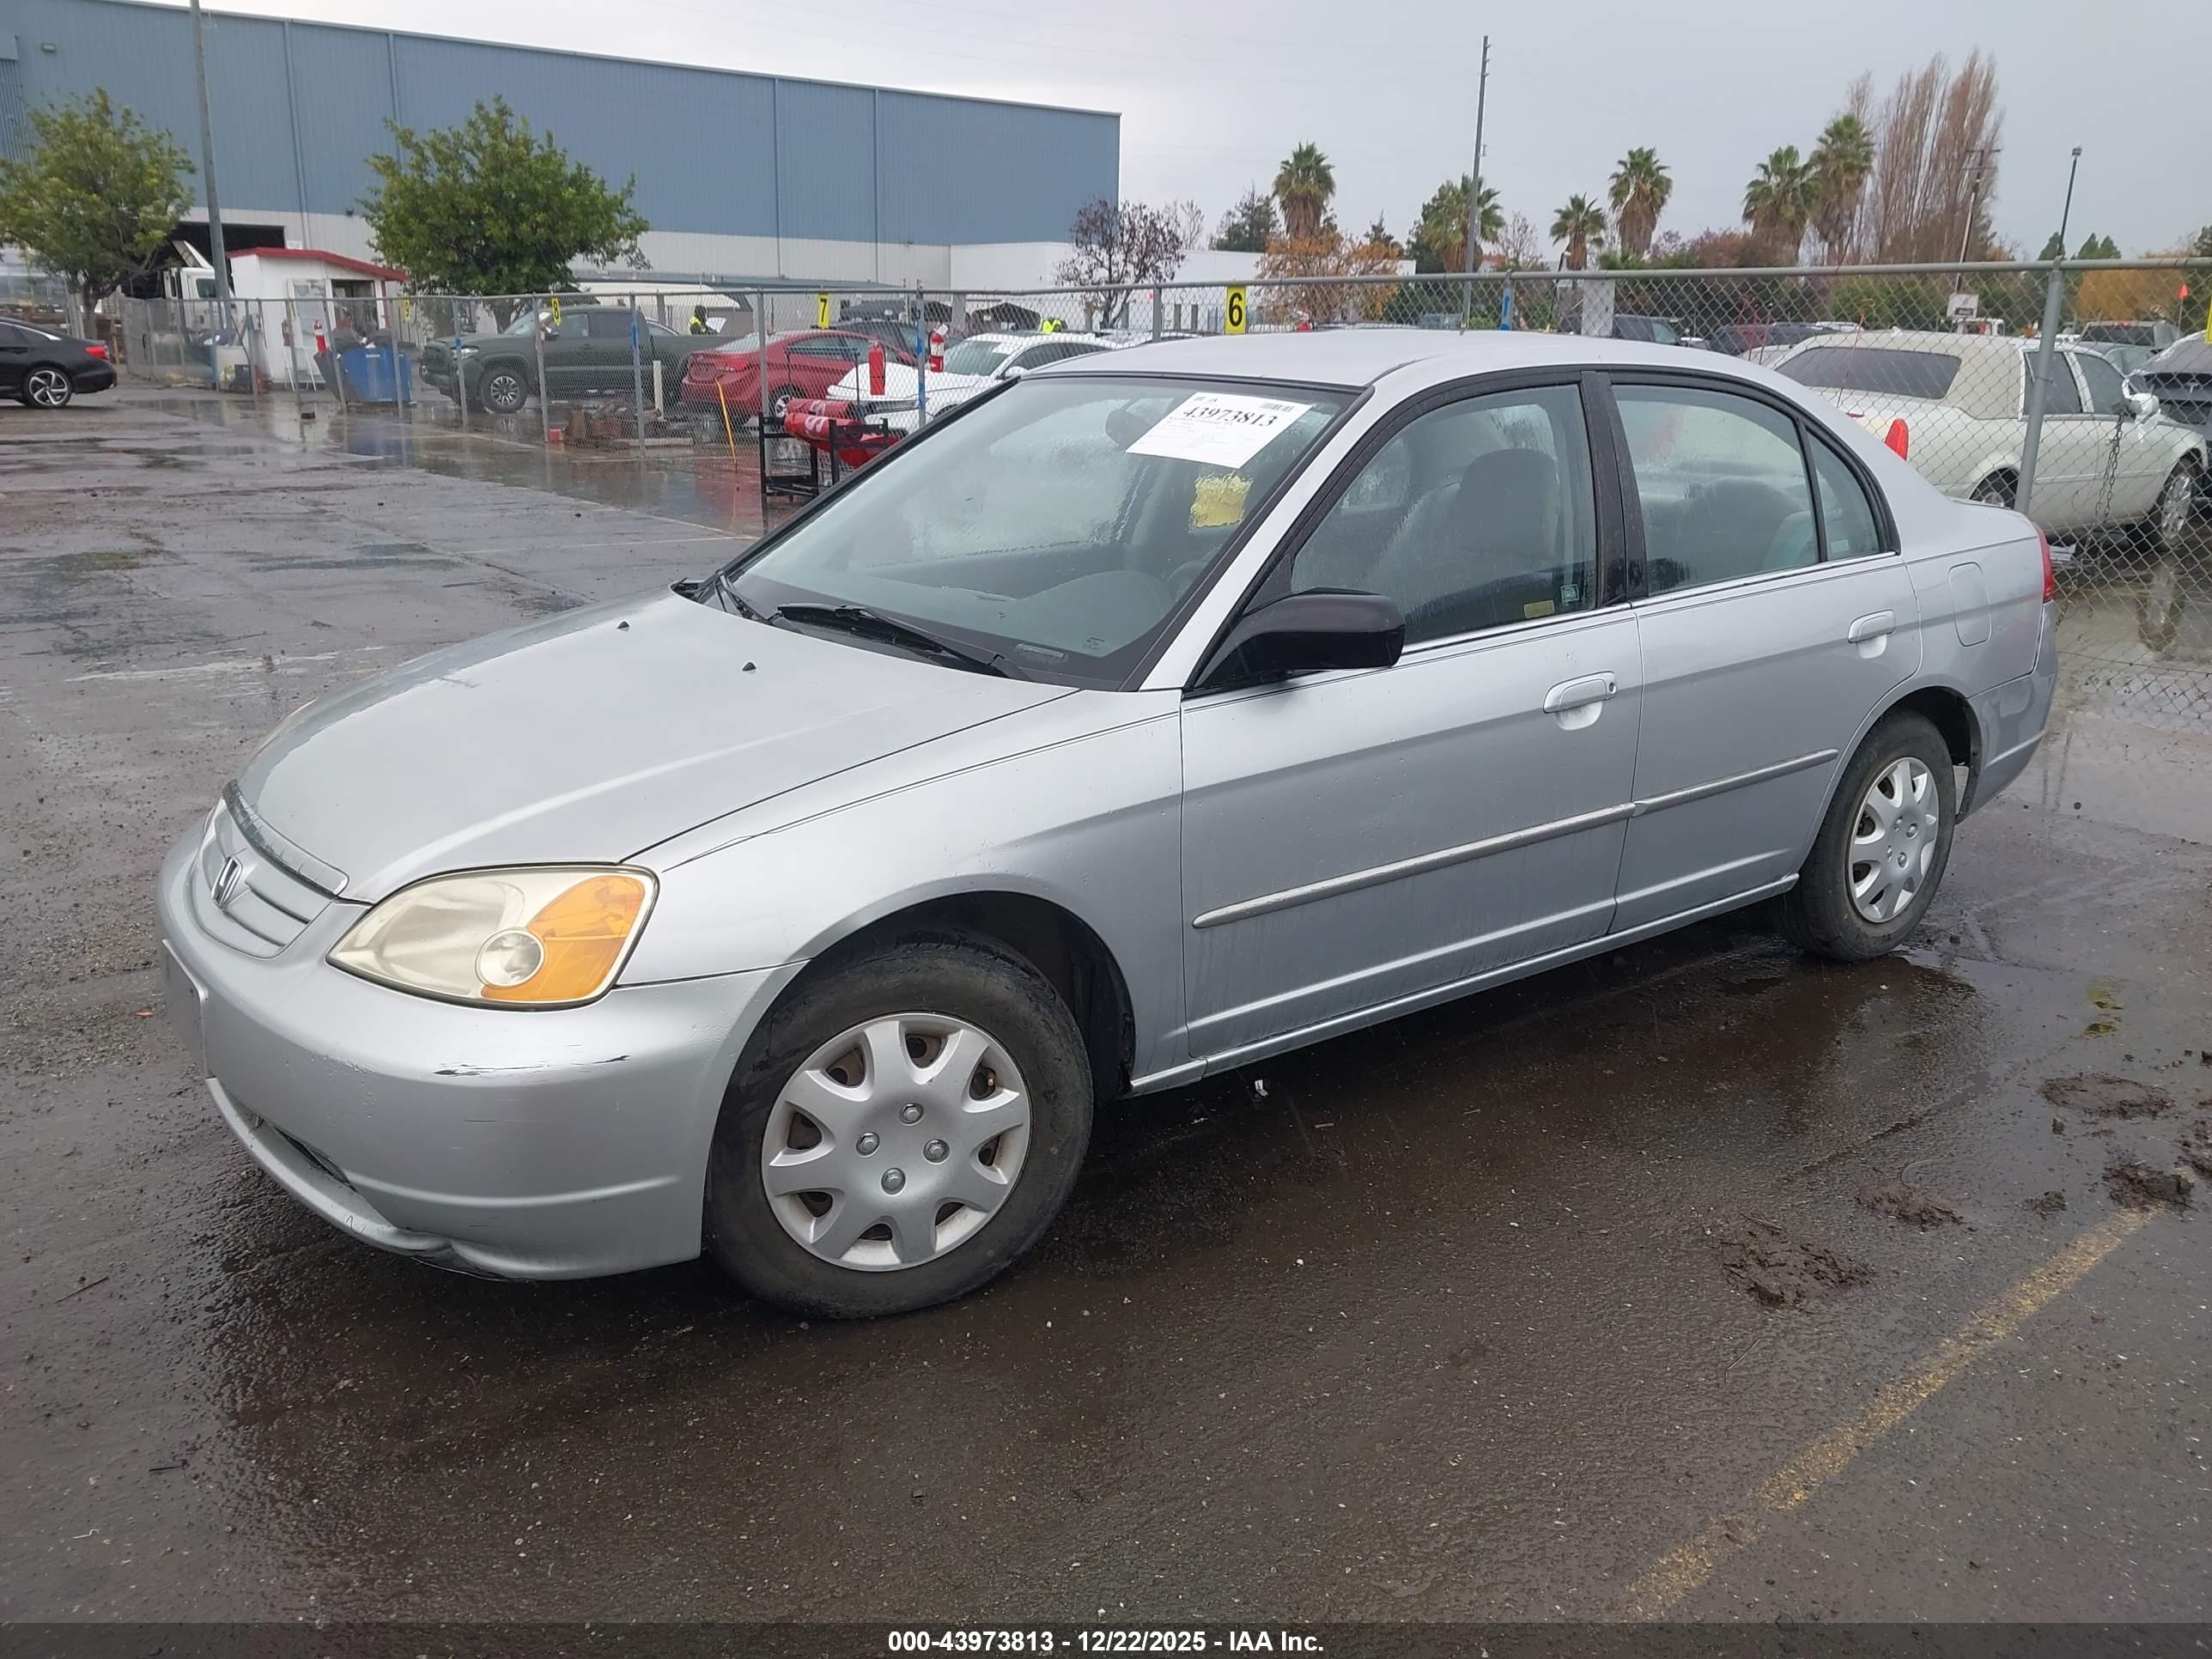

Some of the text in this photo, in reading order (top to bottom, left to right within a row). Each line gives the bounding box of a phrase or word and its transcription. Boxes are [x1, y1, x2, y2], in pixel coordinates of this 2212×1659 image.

[553, 301, 559, 319] 8
[820, 298, 828, 323] 7
[1229, 292, 1243, 327] 6
[1183, 405, 1278, 427] 43973813
